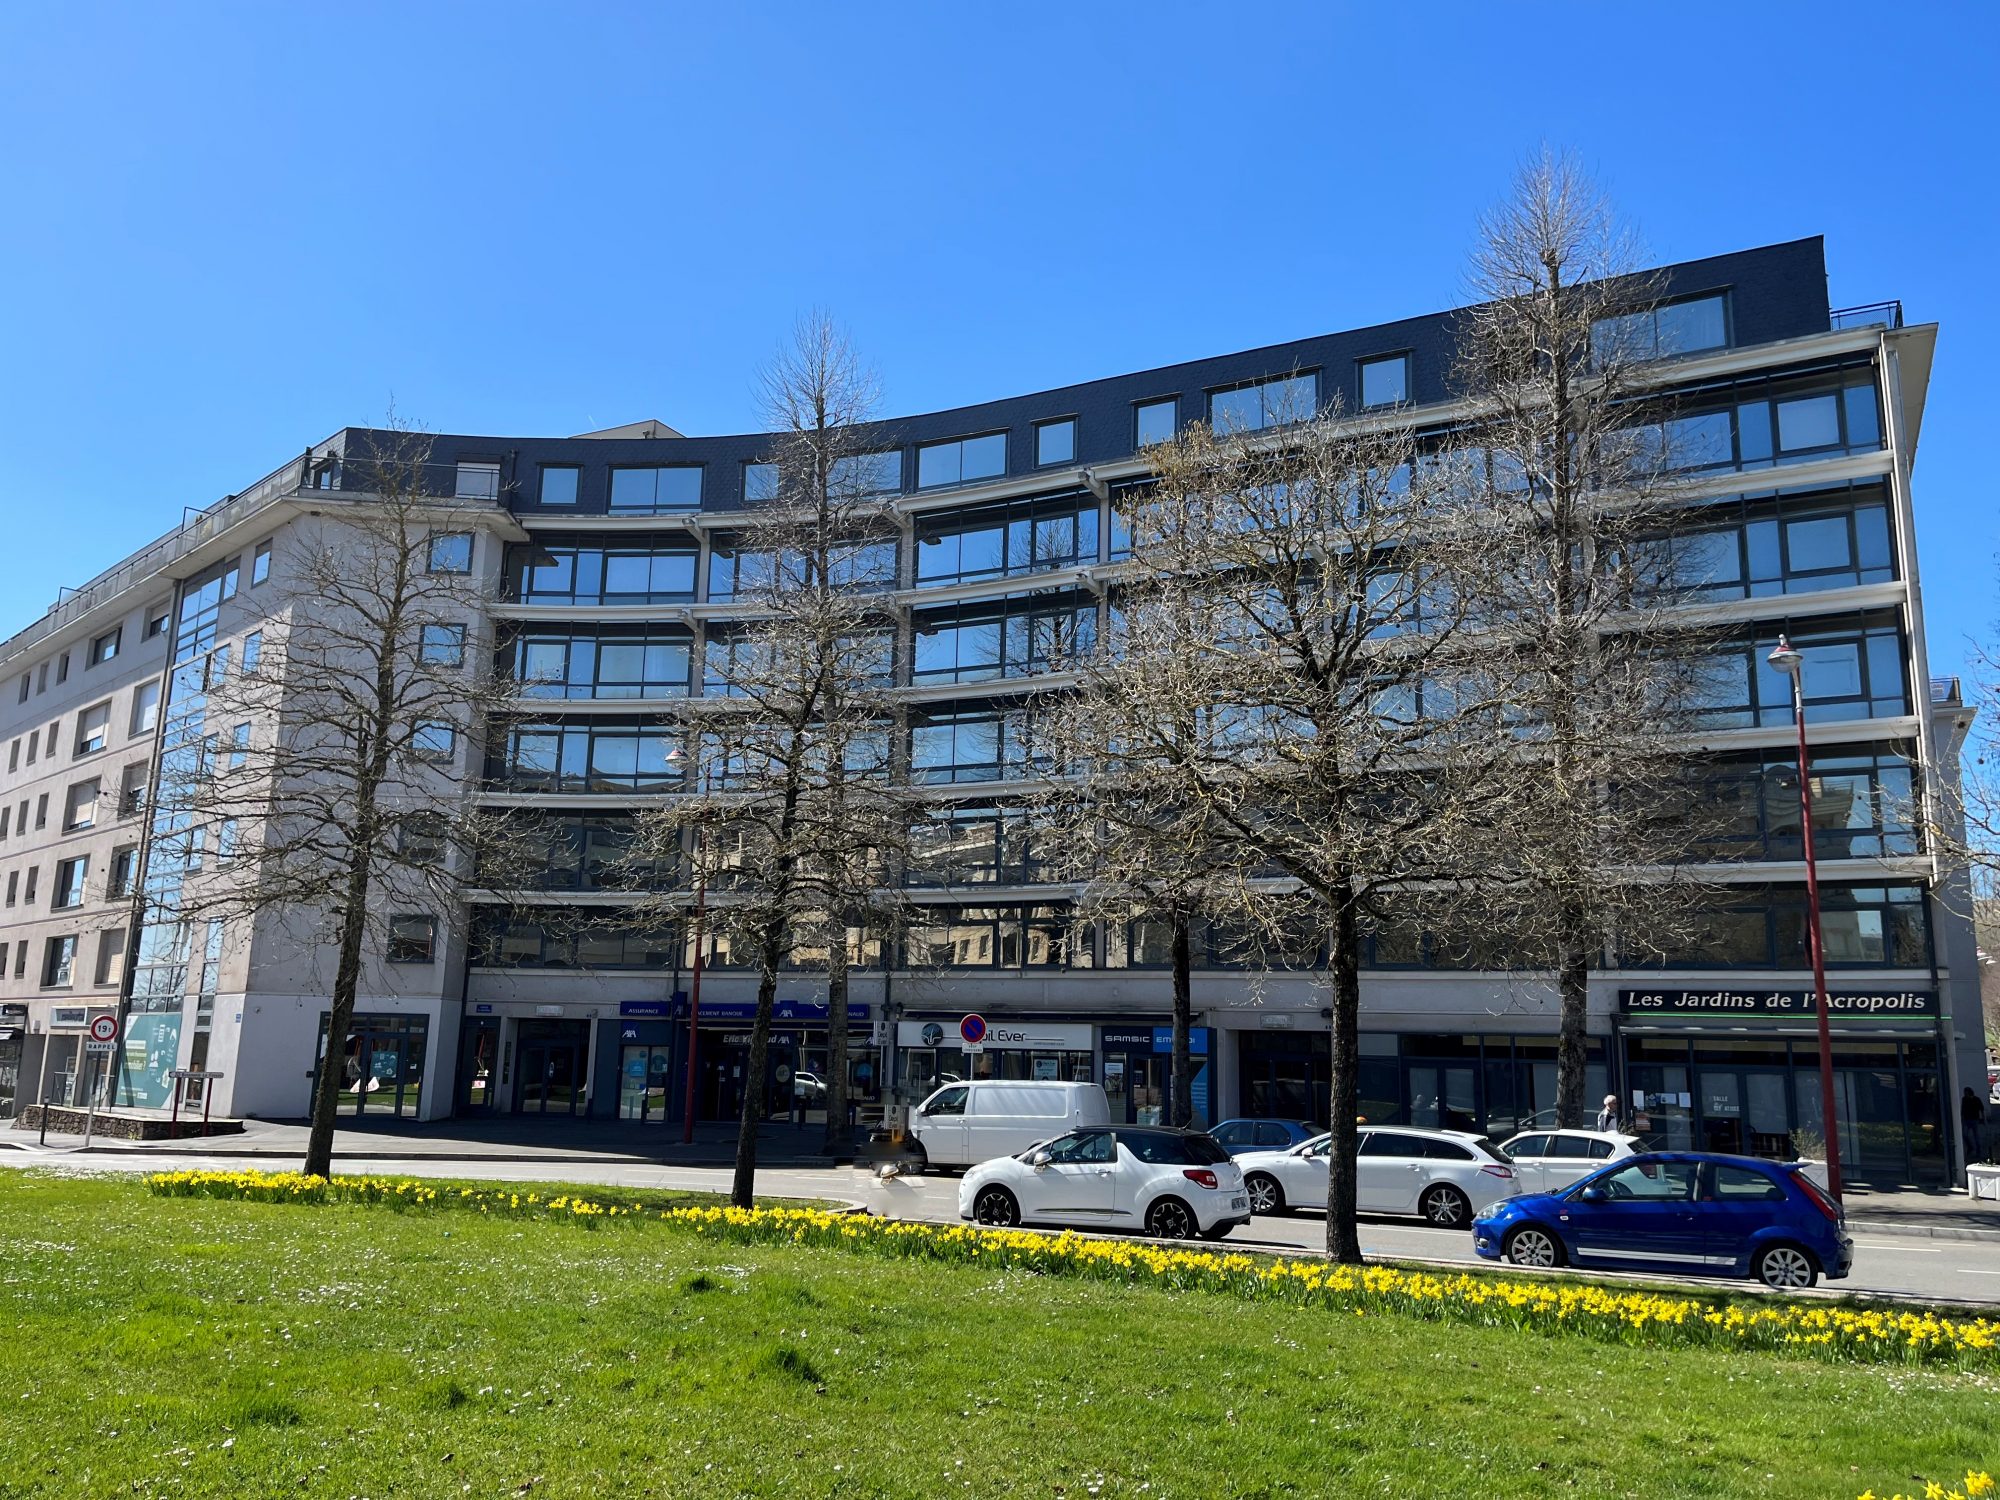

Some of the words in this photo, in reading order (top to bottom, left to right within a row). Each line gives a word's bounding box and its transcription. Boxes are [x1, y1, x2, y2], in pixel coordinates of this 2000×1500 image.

[1628, 991, 1664, 1007] Les
[1674, 992, 1756, 1008] Jardins
[1765, 993, 1792, 1008] de
[780, 1009, 793, 1017] AXA
[621, 1029, 637, 1039] AXA
[998, 1030, 1027, 1042] Ever
[778, 1036, 789, 1044] AXA
[1104, 1035, 1151, 1043] SAMSIC
